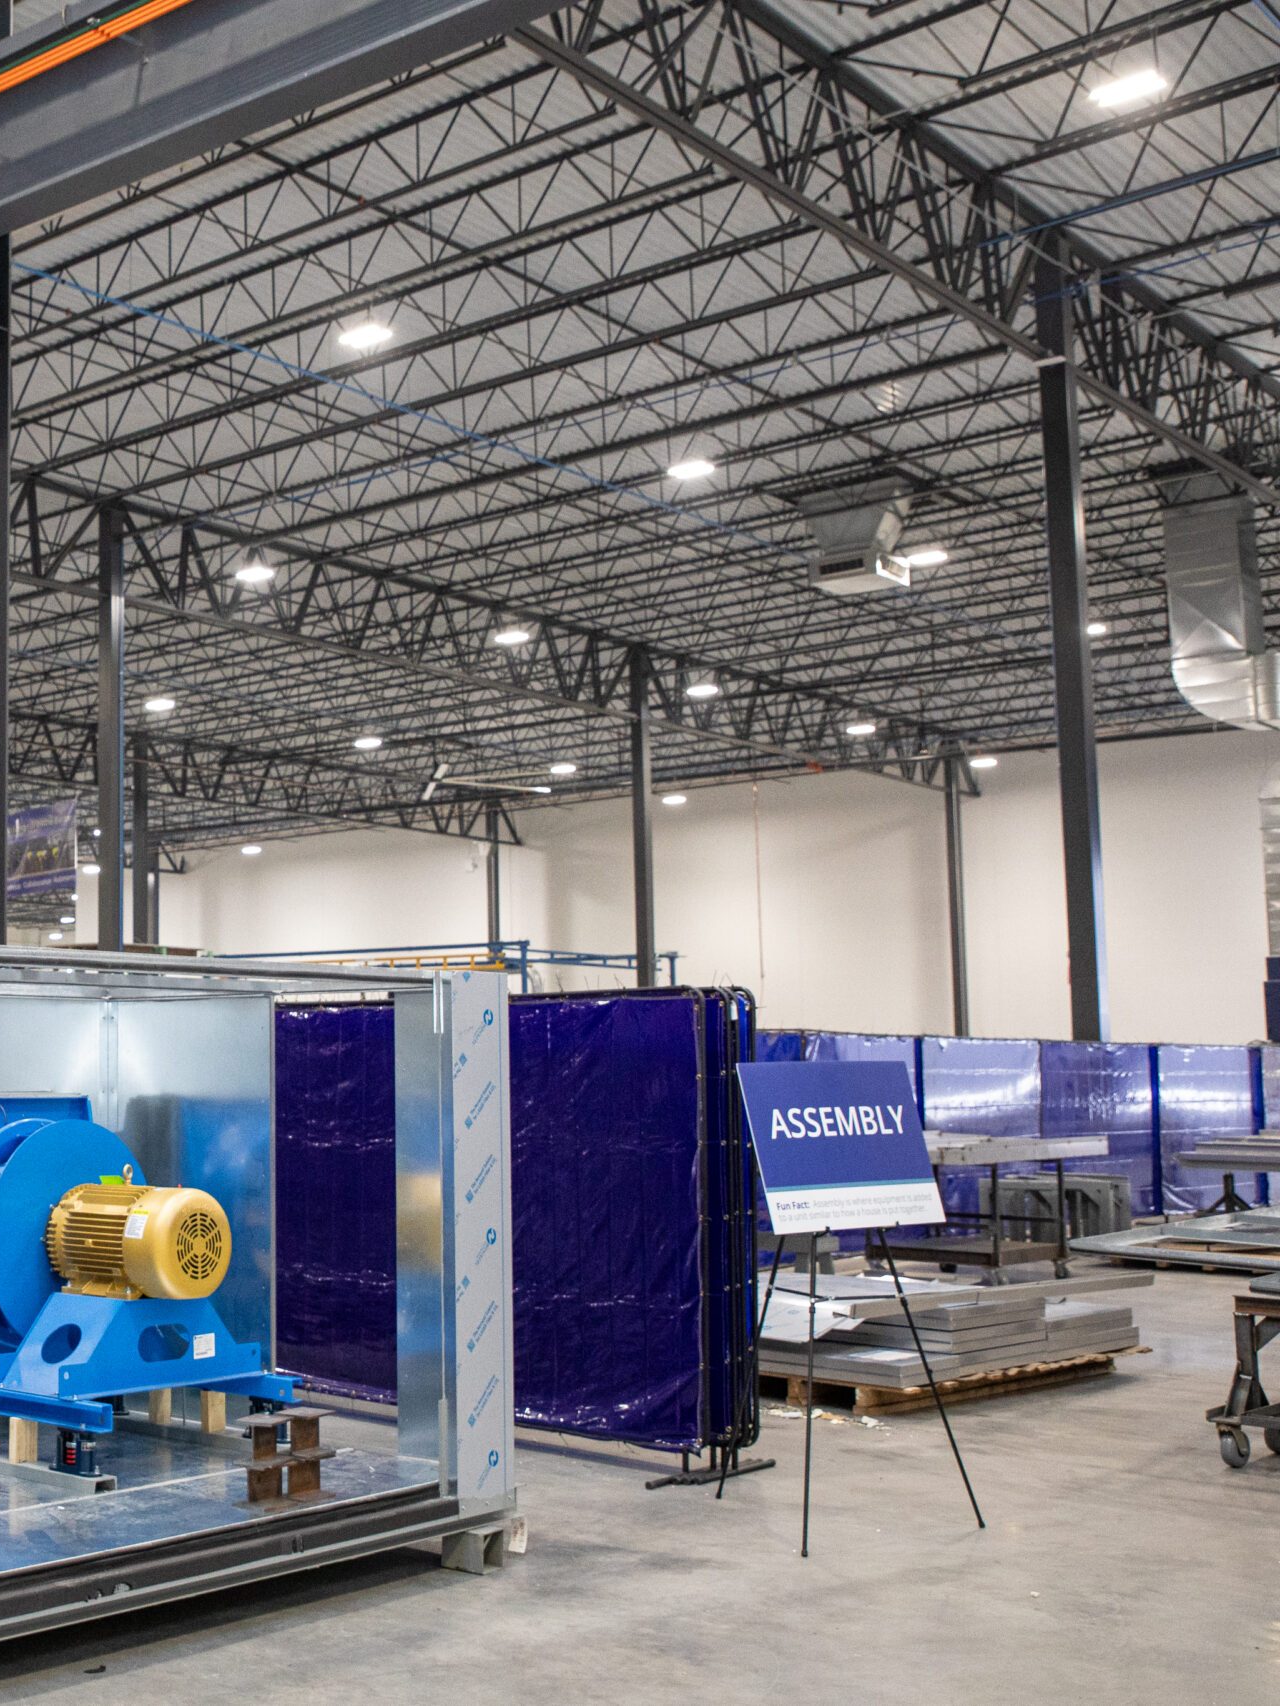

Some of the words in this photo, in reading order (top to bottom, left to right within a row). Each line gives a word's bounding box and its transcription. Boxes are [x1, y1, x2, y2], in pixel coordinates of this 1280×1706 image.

[771, 1105, 904, 1140] ASSEMBLY
[776, 1202, 791, 1211] Fun
[791, 1201, 810, 1210] Fact:
